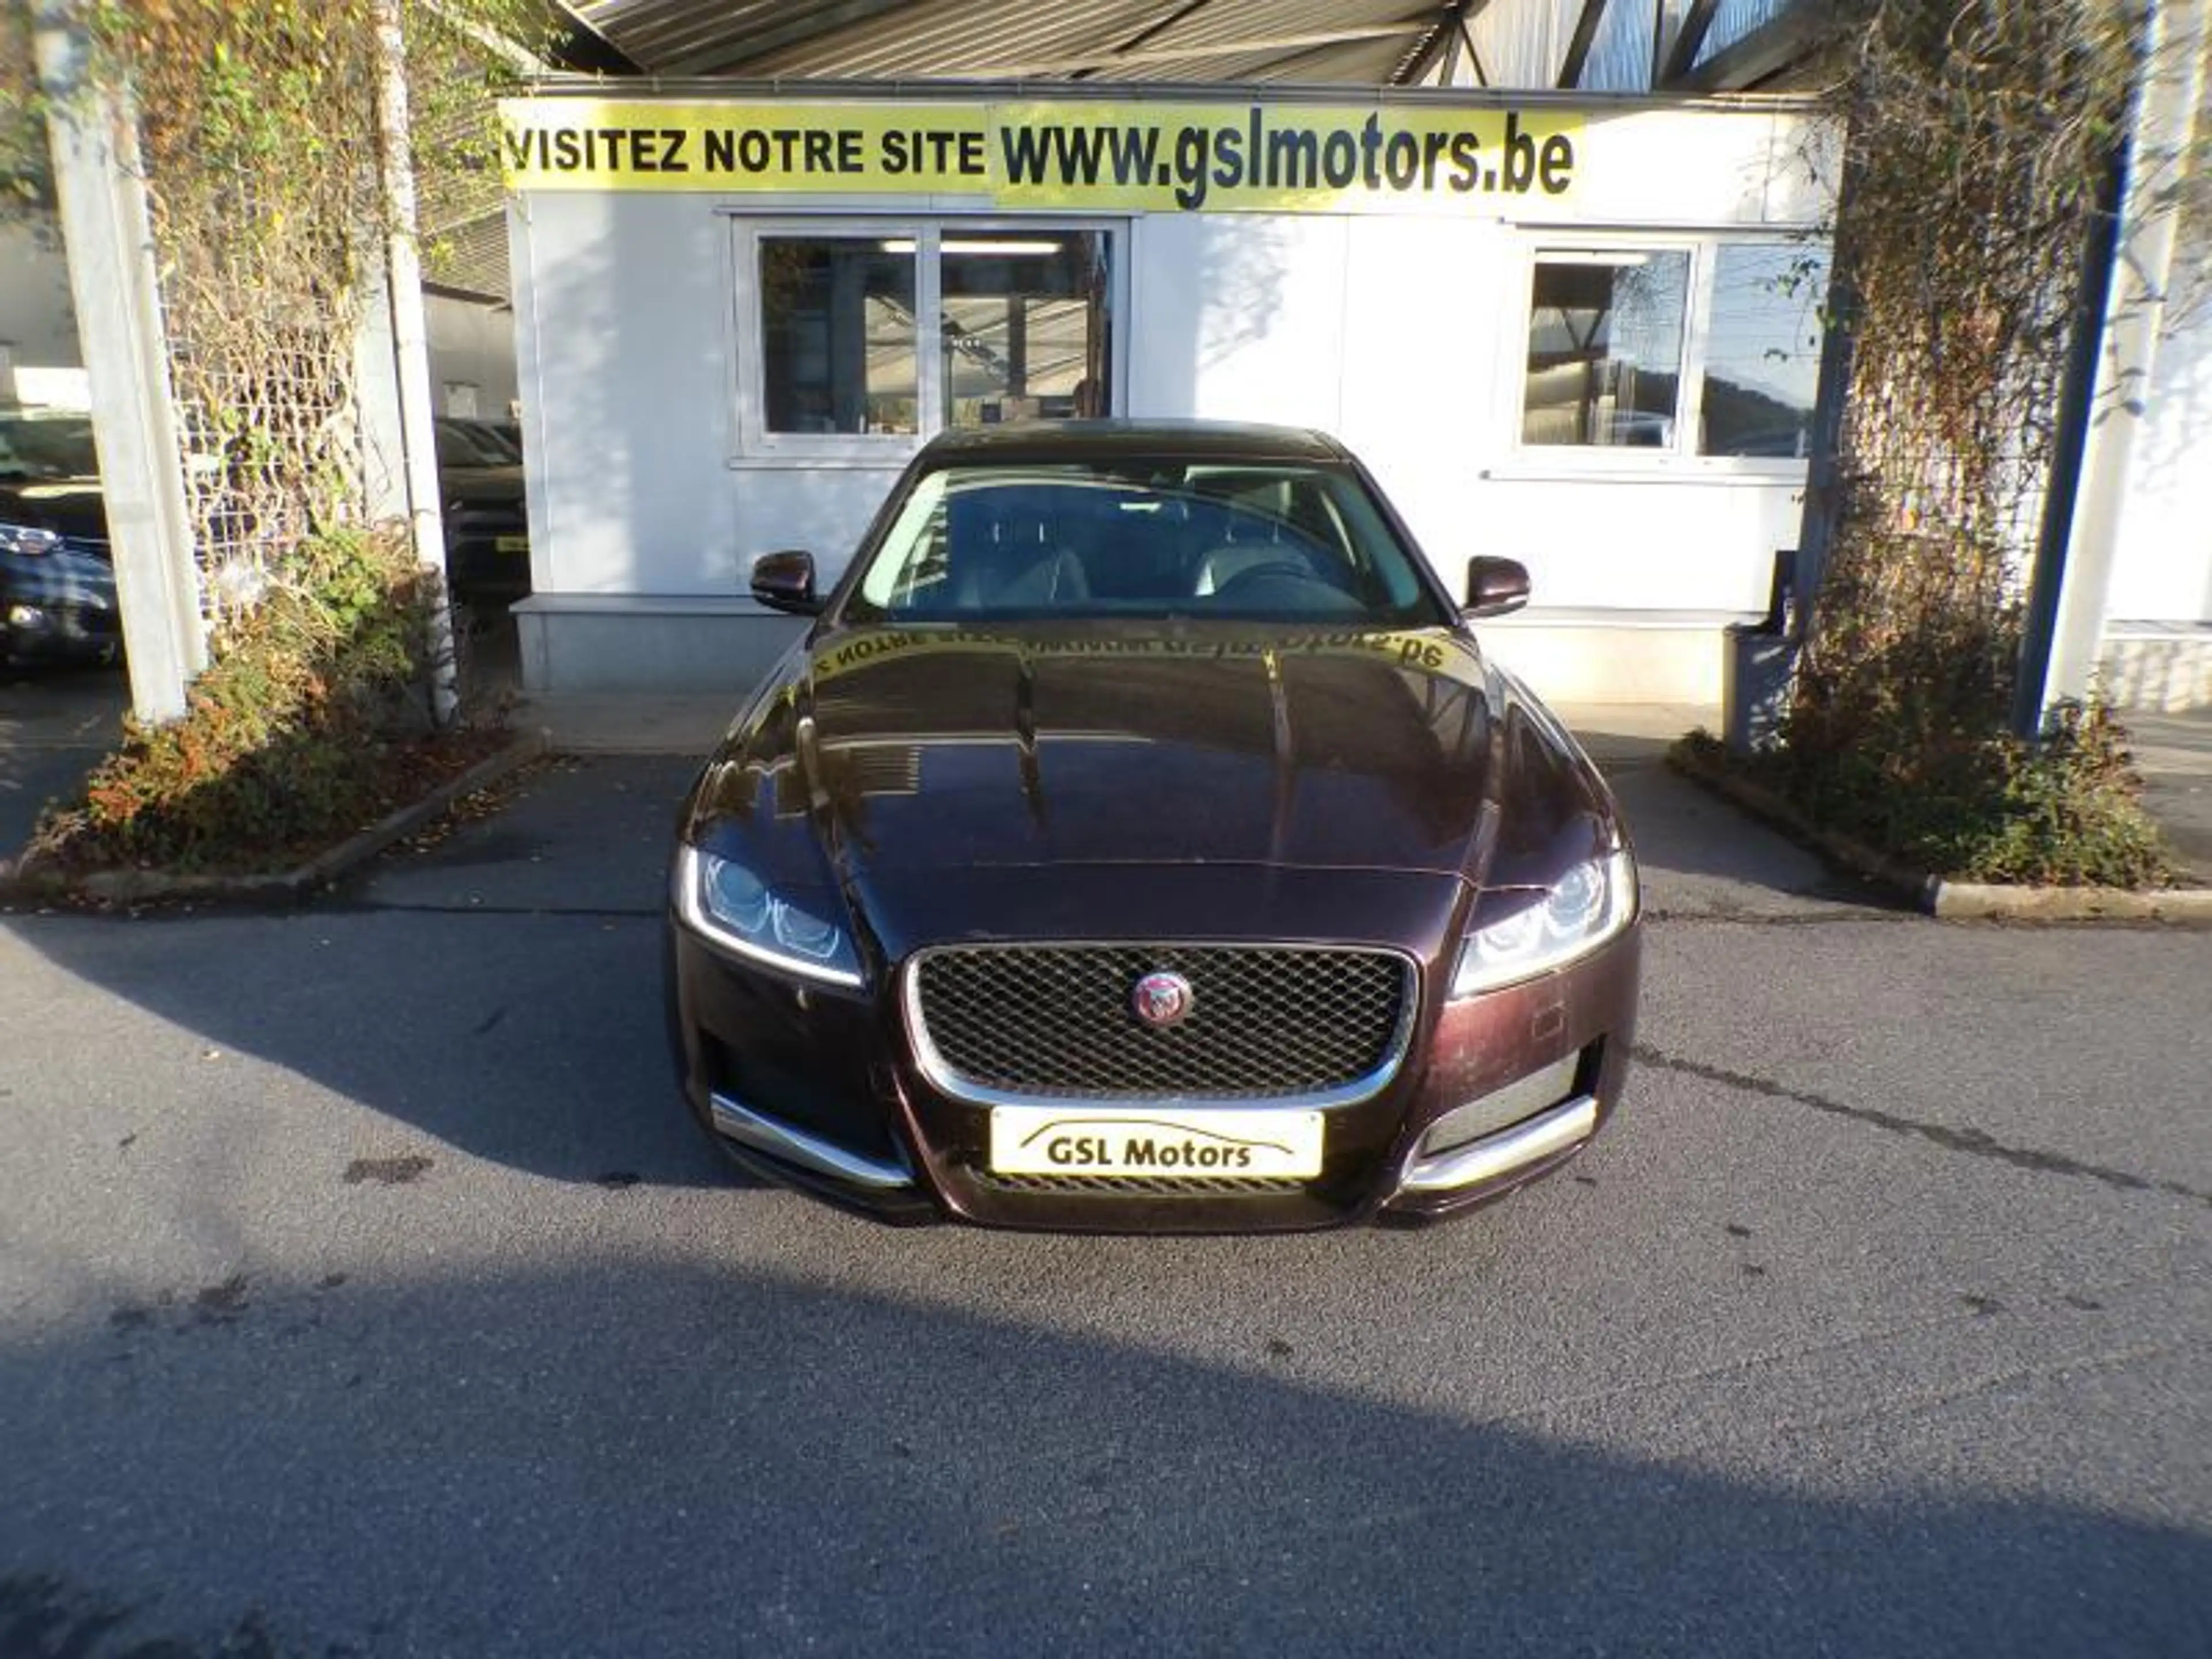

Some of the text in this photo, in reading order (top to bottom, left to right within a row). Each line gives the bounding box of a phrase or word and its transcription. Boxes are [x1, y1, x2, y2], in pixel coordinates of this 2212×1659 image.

[505, 107, 1572, 209] VISITEZ NOTRE SITE www.gslmotors.be
[1047, 1138, 1251, 1168] GSL Motors
